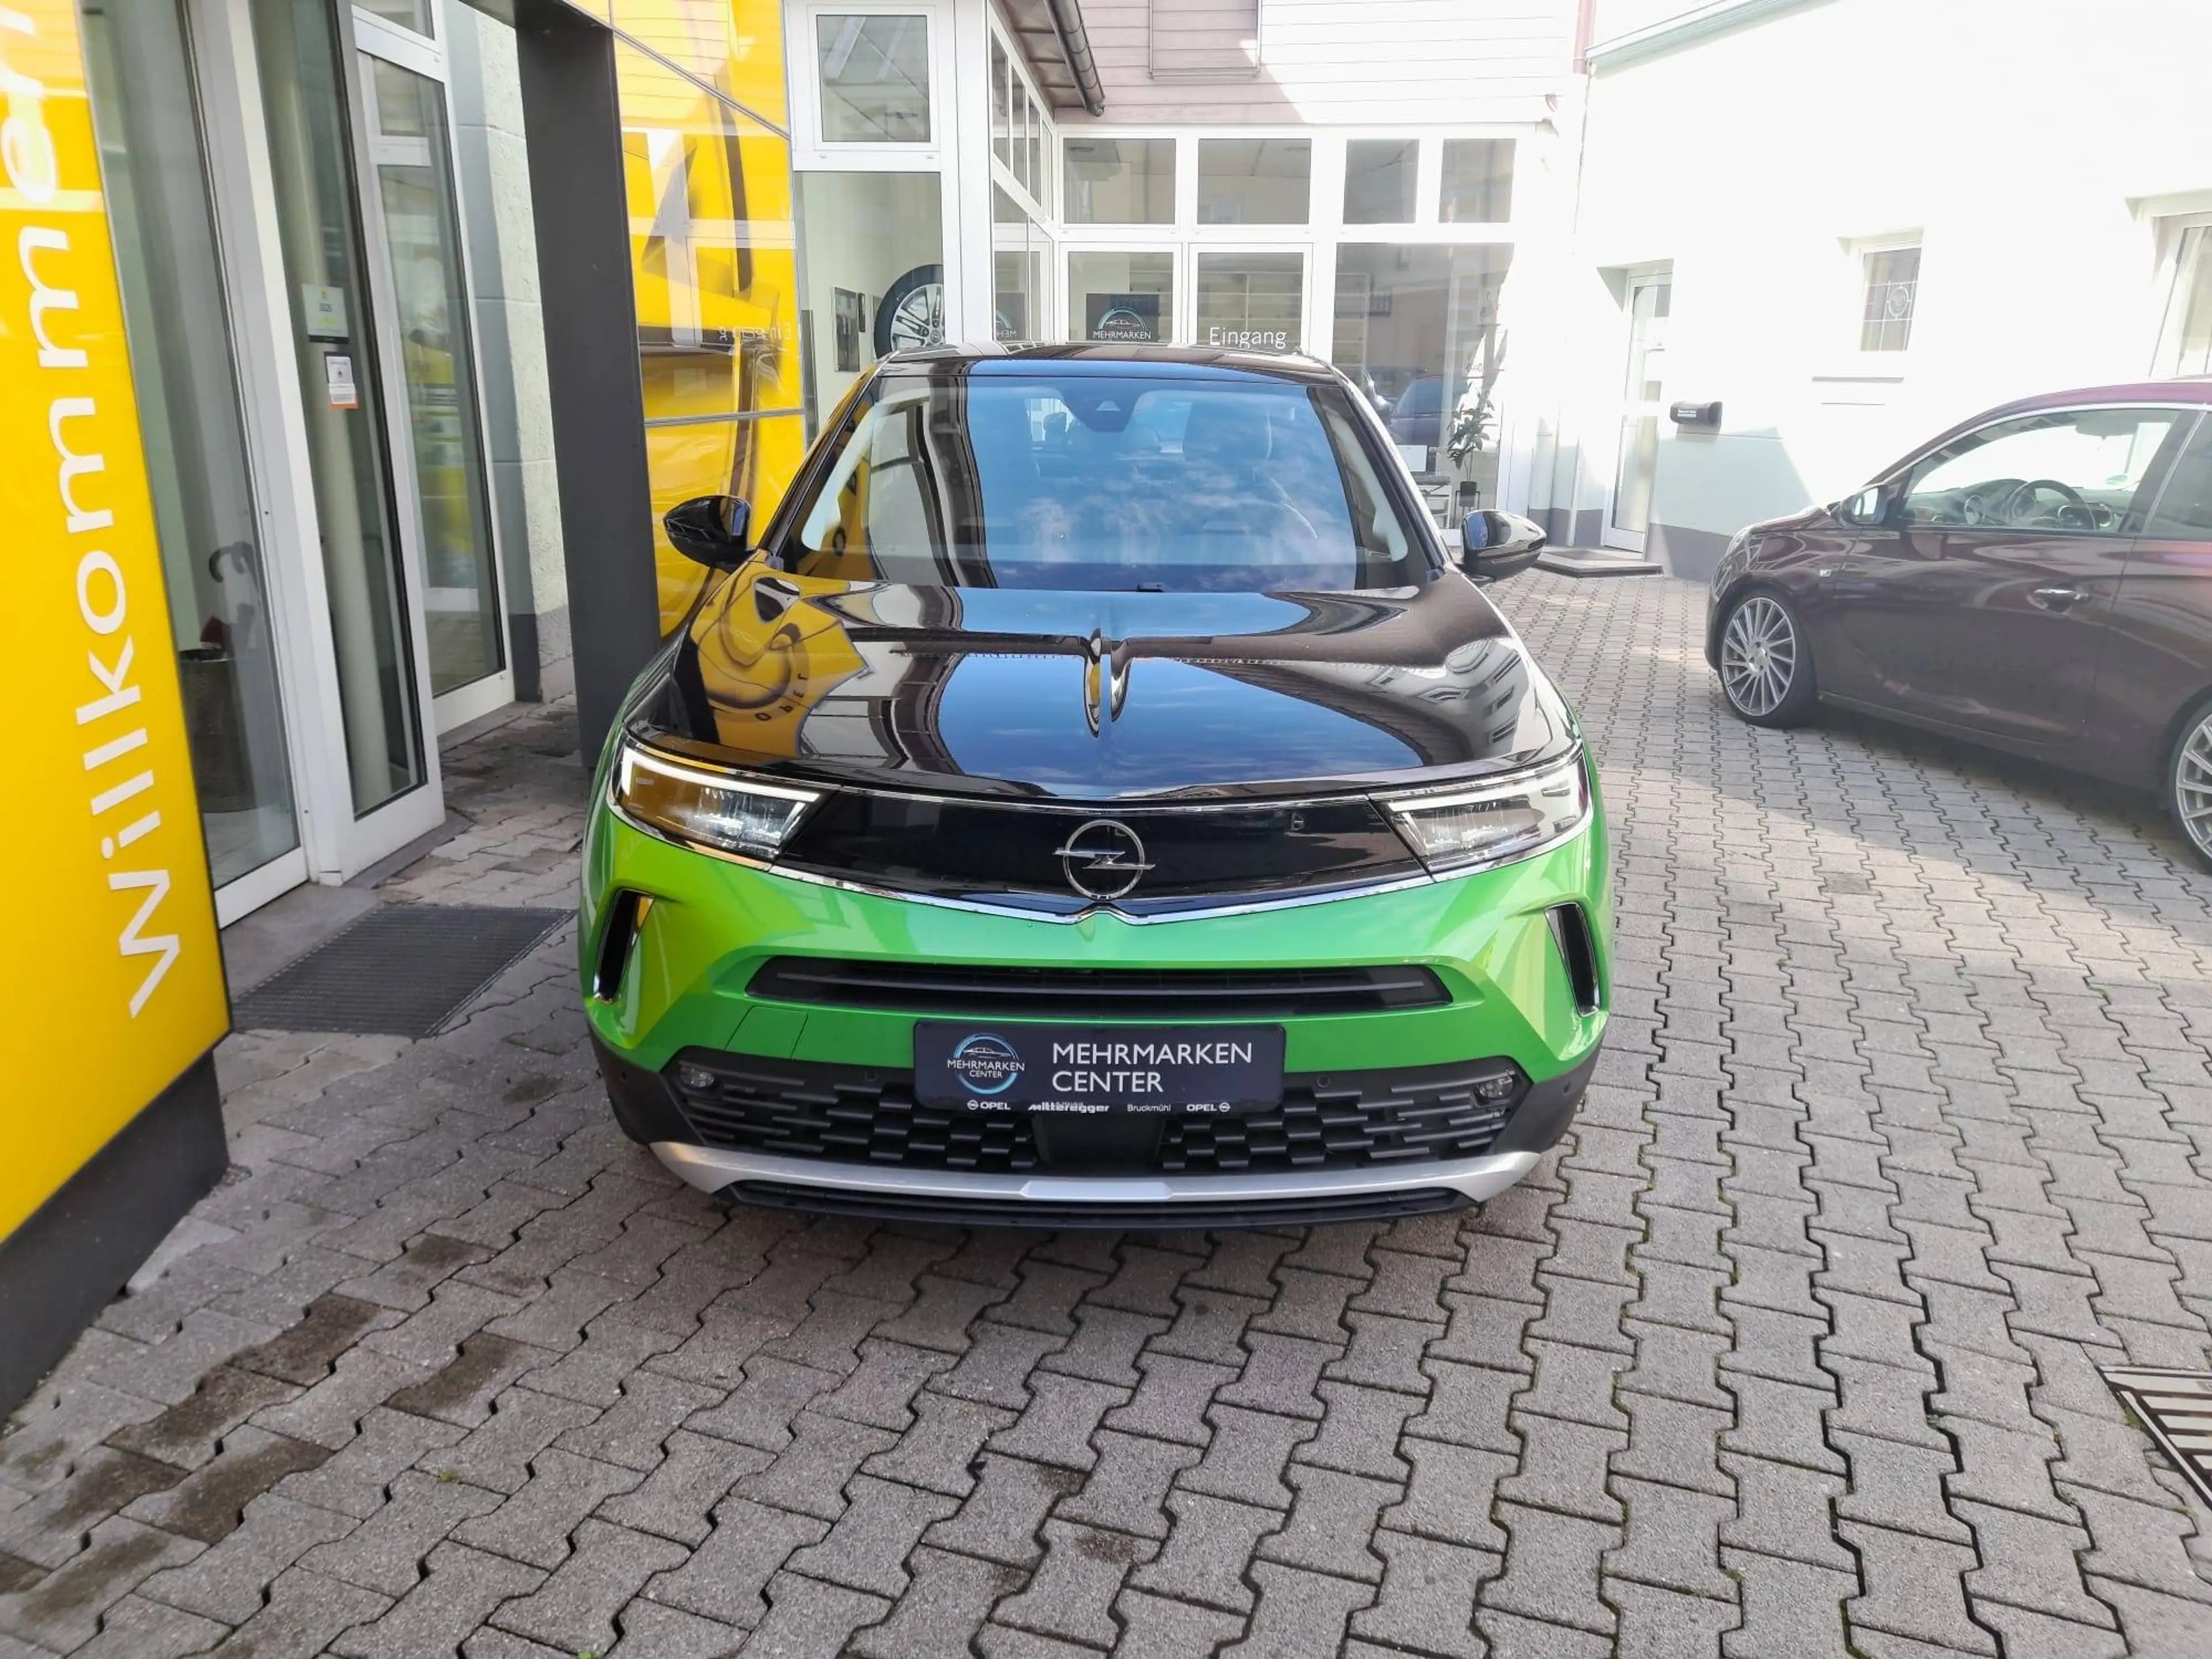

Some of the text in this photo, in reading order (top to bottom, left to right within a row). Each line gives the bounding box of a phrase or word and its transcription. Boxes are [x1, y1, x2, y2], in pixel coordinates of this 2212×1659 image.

[1093, 330, 1151, 340] MEHRMARKEN
[1210, 327, 1286, 349] Eingang
[1052, 1043, 1252, 1065] MEHRMARKEN
[947, 1059, 1025, 1071] MEHRMARKEN
[969, 1070, 1002, 1078] CENTER
[1052, 1070, 1164, 1092] CENTER
[980, 1101, 1011, 1111] OPEL
[1127, 1103, 1171, 1112] Bruckmühl
[1186, 1103, 1217, 1112] OPEL
